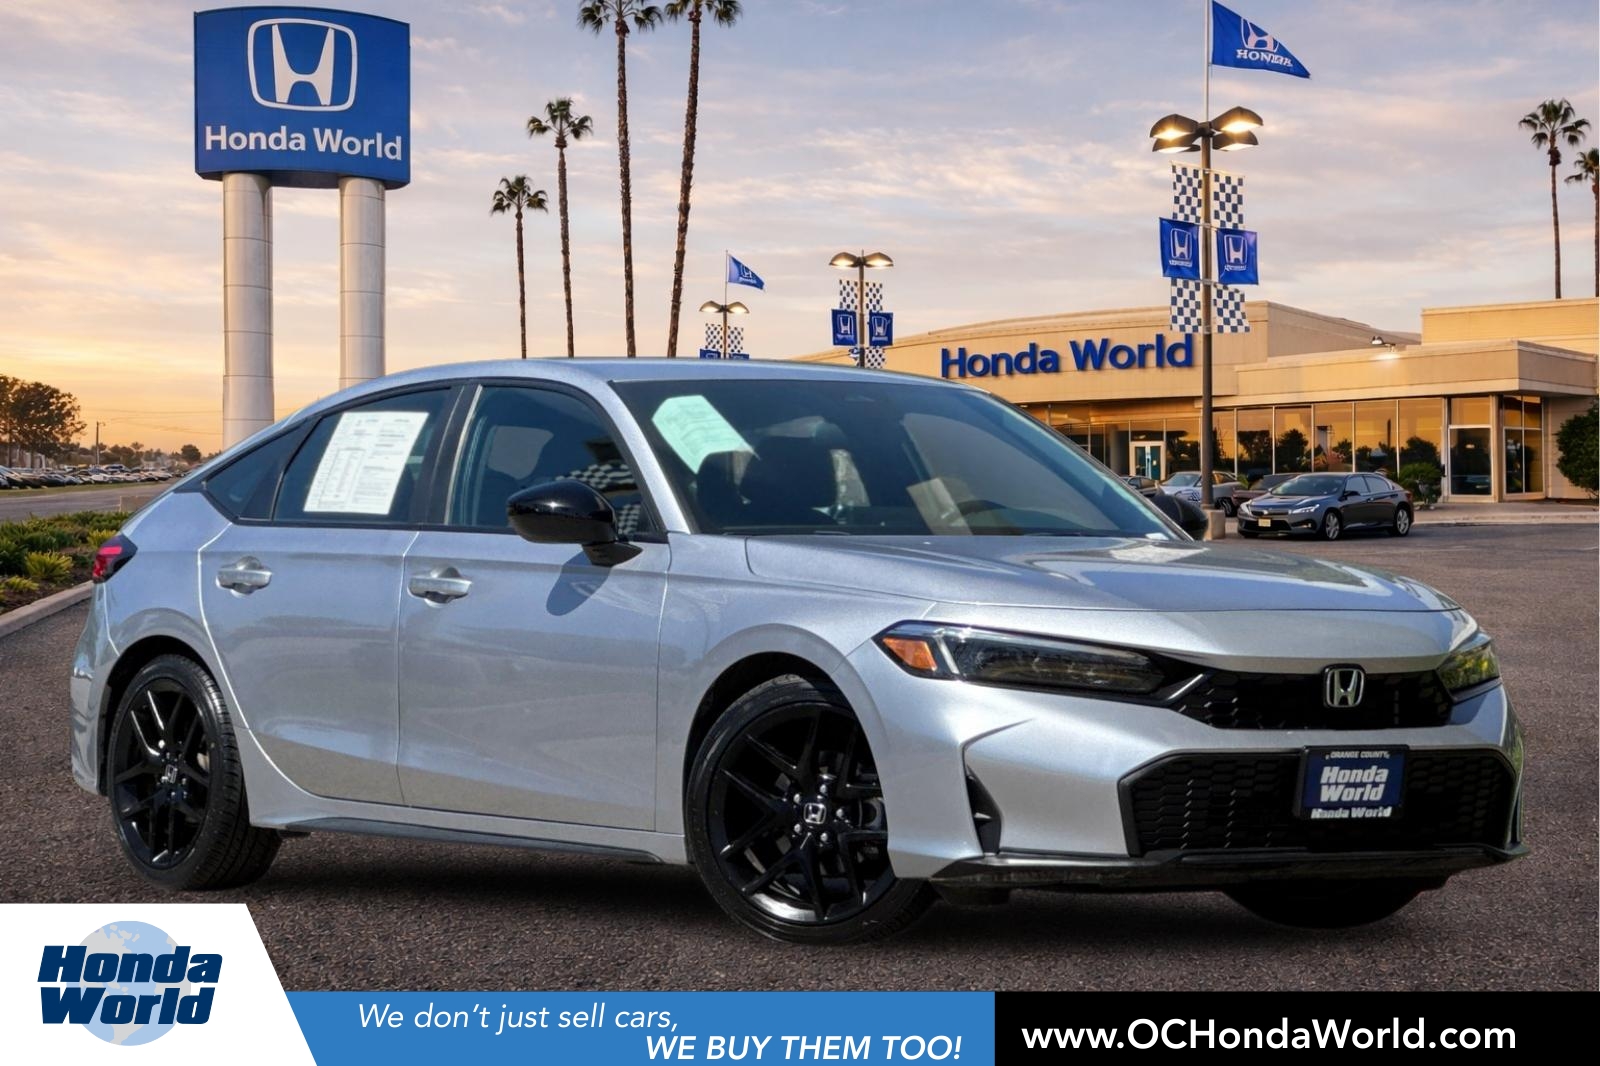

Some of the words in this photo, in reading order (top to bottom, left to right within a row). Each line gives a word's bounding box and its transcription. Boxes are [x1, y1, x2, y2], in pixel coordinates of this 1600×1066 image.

[205, 125, 306, 151] Honda
[313, 127, 402, 161] World
[941, 342, 1062, 379] Honda
[1069, 333, 1195, 372] World
[1319, 765, 1389, 784] Honda
[1320, 783, 1385, 802] World
[1310, 808, 1350, 819] Honda
[1350, 806, 1393, 818] World
